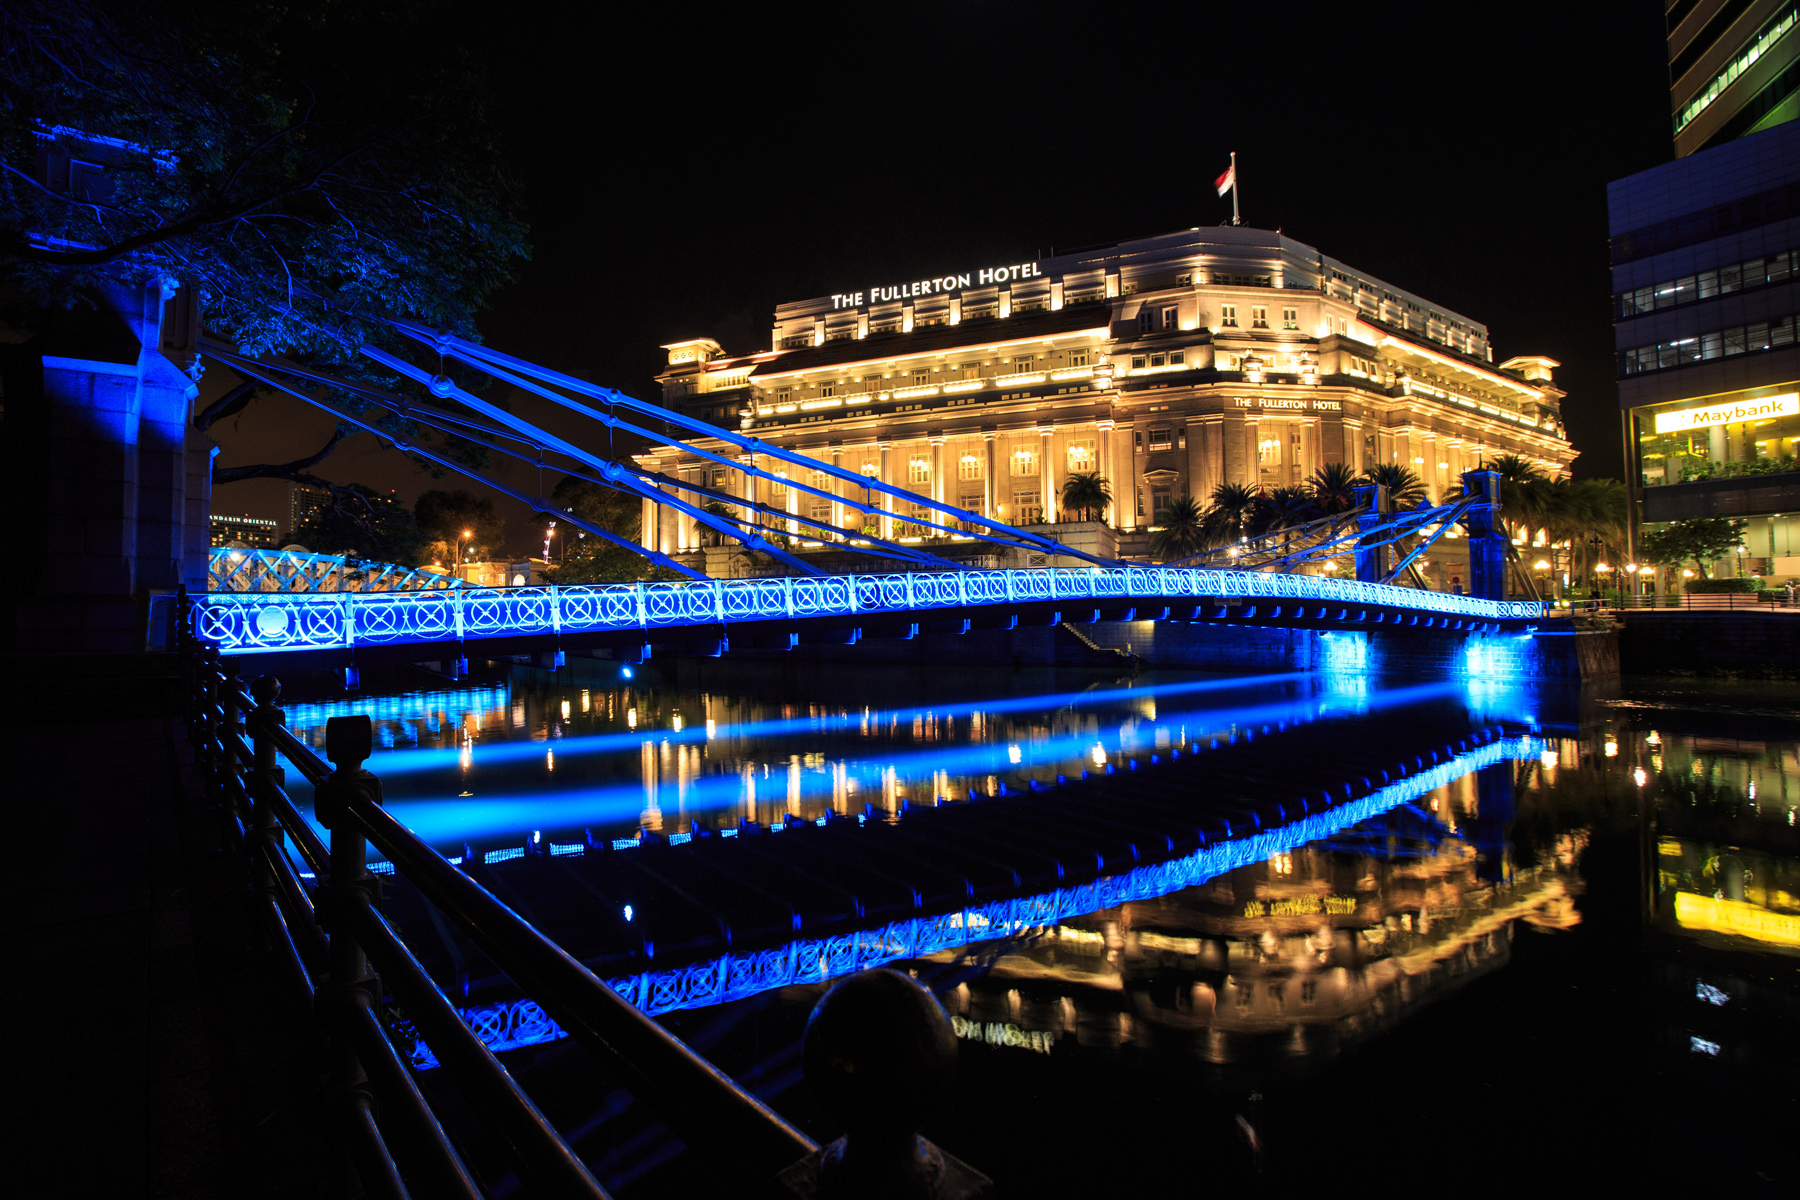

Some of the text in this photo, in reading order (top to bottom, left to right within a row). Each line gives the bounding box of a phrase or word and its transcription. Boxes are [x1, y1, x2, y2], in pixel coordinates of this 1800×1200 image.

[831, 262, 1042, 309] THE FULLERTON HOTEL
[1234, 397, 1342, 410] THE FULLERTON HOTEL
[1693, 400, 1784, 423] Maybank
[209, 514, 277, 526] ANDARIN ORIENTAL
